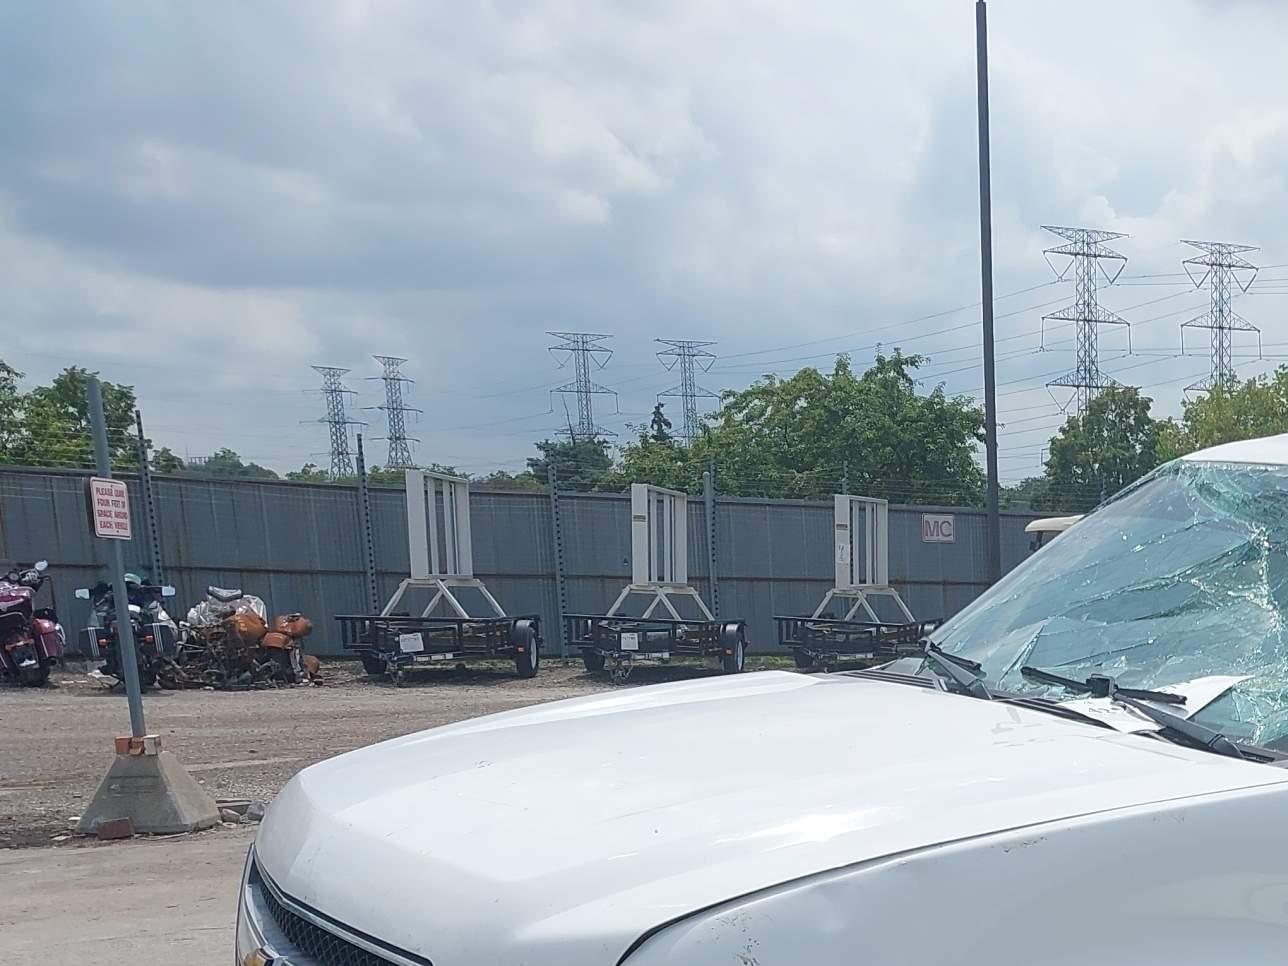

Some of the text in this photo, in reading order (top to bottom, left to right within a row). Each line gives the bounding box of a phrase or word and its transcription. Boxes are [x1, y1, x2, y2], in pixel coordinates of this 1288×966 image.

[95, 487, 113, 496] PLEASE
[100, 520, 113, 529] EACH
[924, 520, 953, 537] MC
